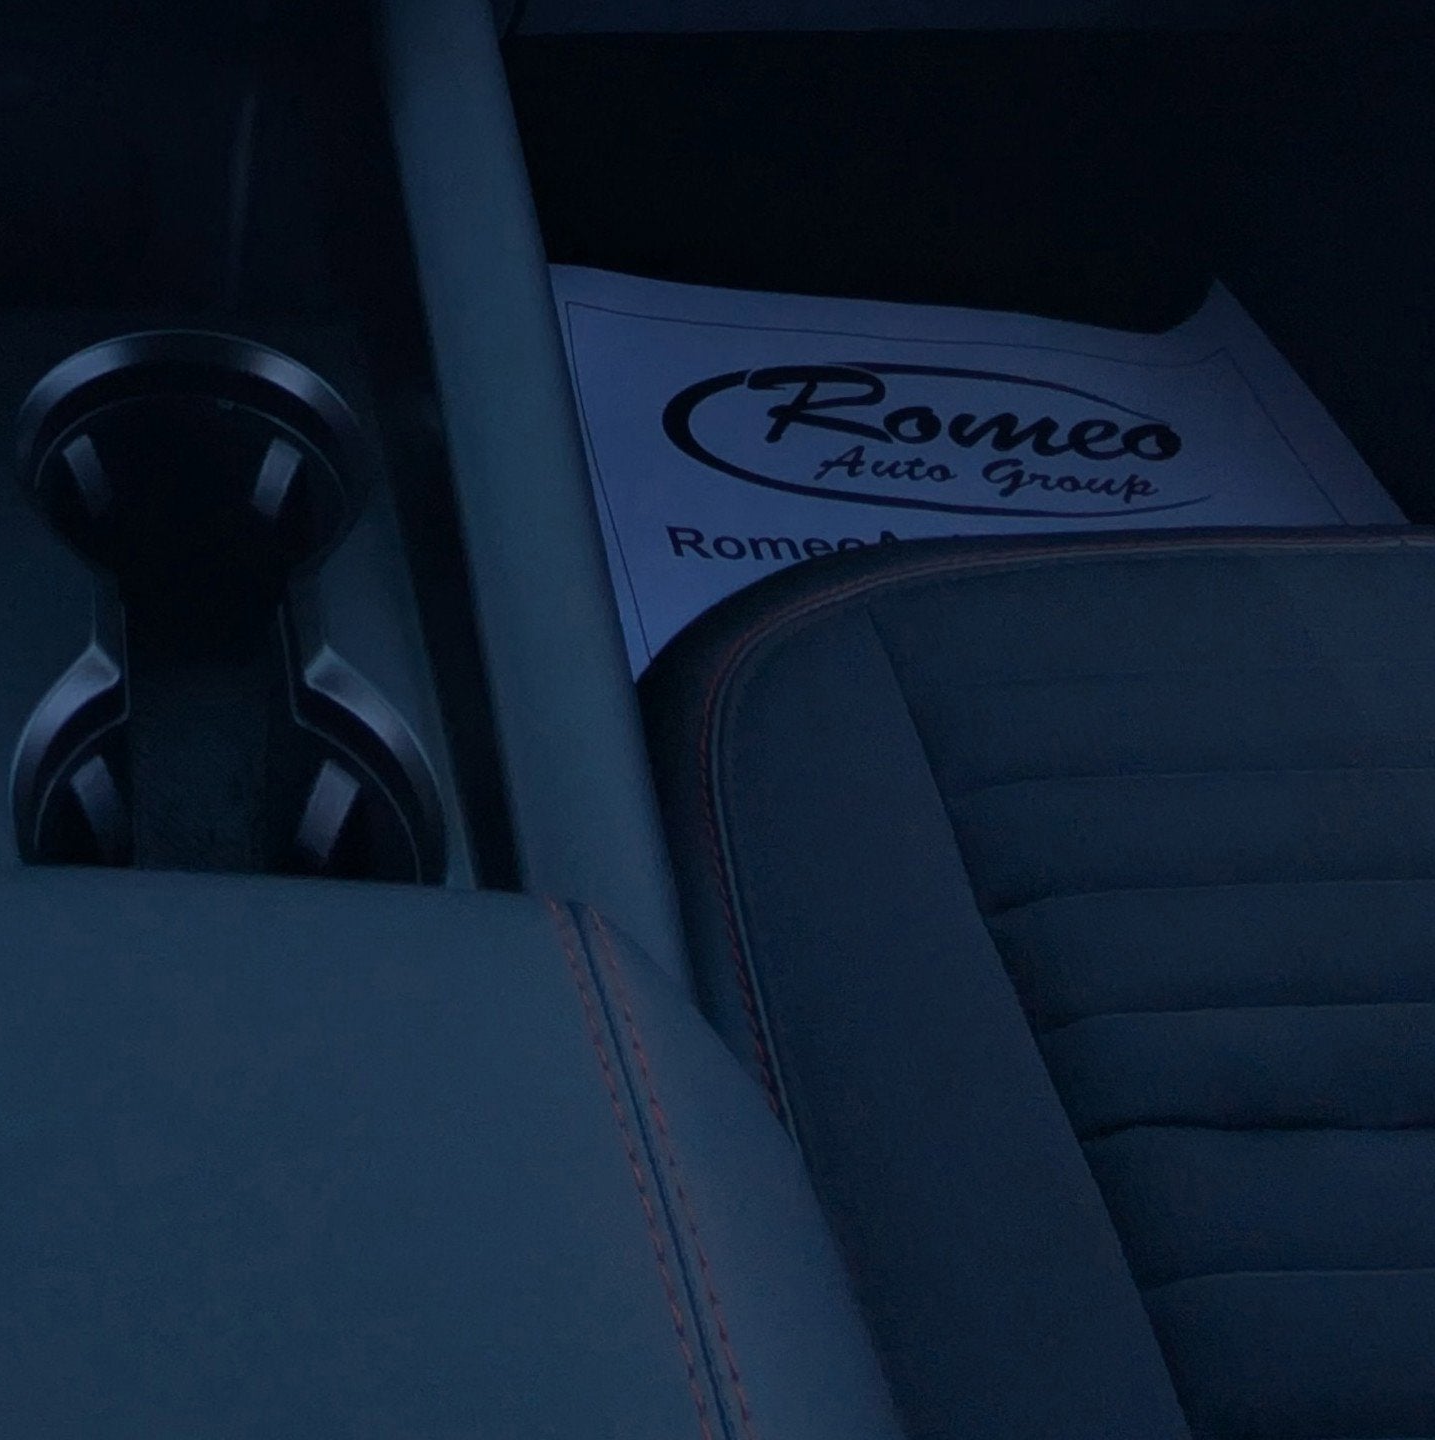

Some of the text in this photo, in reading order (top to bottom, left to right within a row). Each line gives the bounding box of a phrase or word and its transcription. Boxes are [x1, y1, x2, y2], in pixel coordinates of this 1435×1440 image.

[746, 364, 1182, 461] Romeo
[815, 445, 1160, 504] Auto Group
